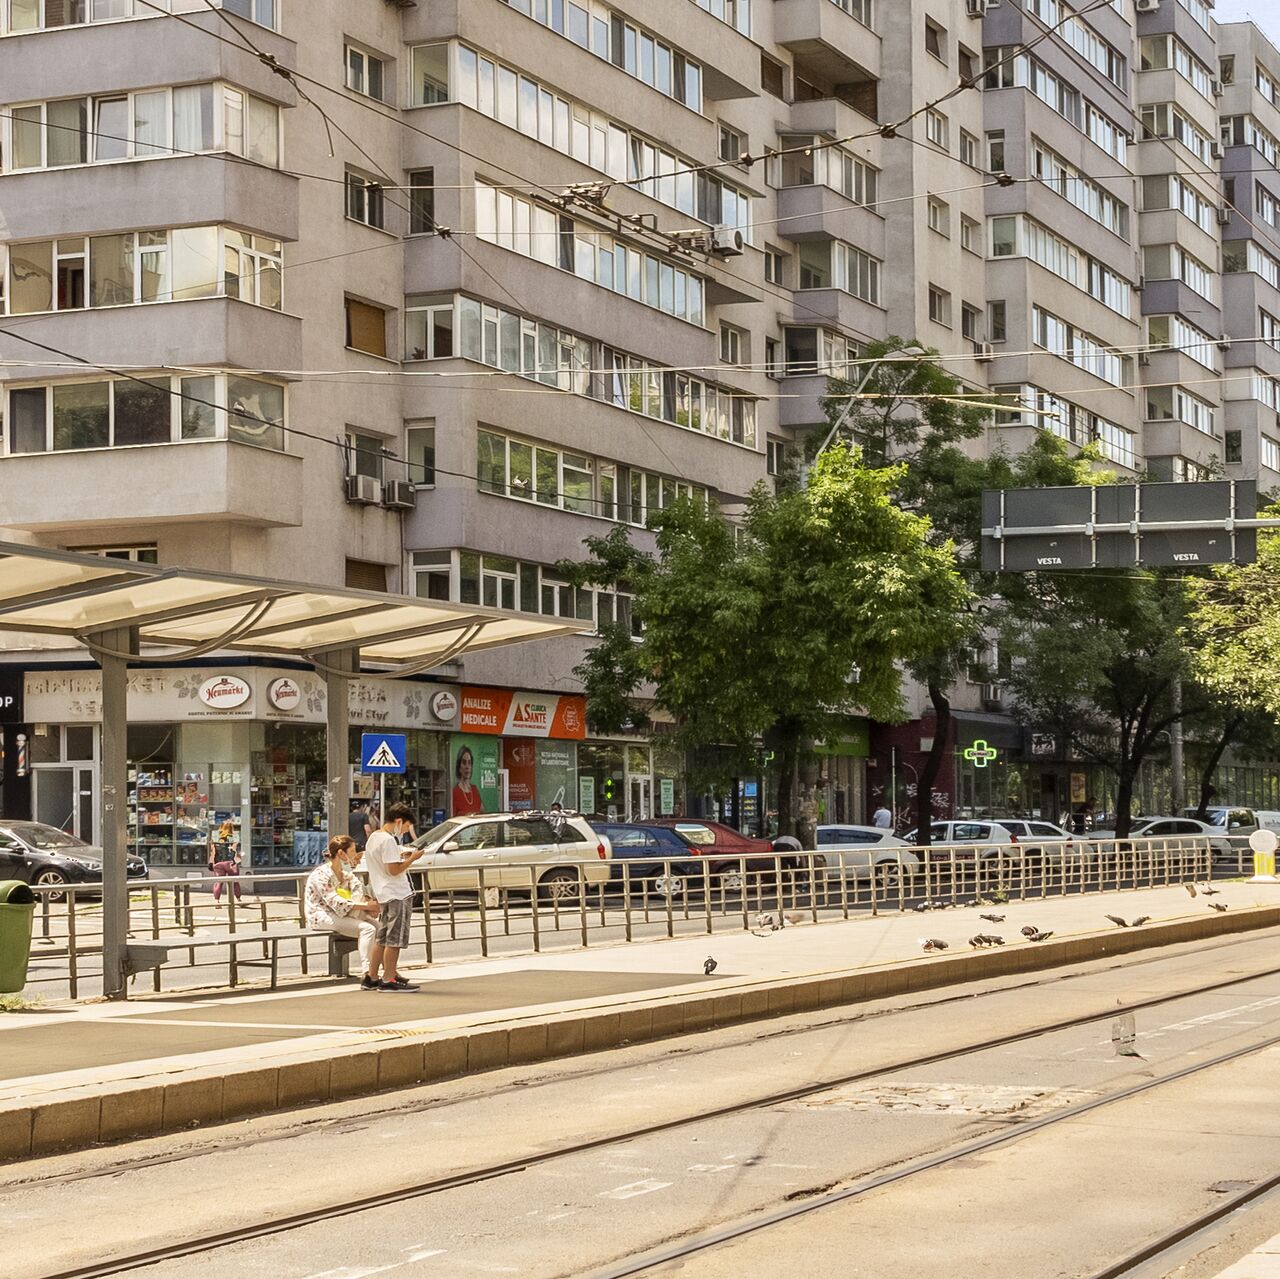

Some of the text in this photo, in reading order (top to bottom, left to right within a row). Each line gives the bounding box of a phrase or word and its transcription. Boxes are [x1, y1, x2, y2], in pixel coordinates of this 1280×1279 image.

[1173, 553, 1199, 561] VESTA
[205, 686, 244, 701] Neumarkt
[462, 697, 492, 710] ANALIZE
[462, 713, 497, 726] MEDICALE
